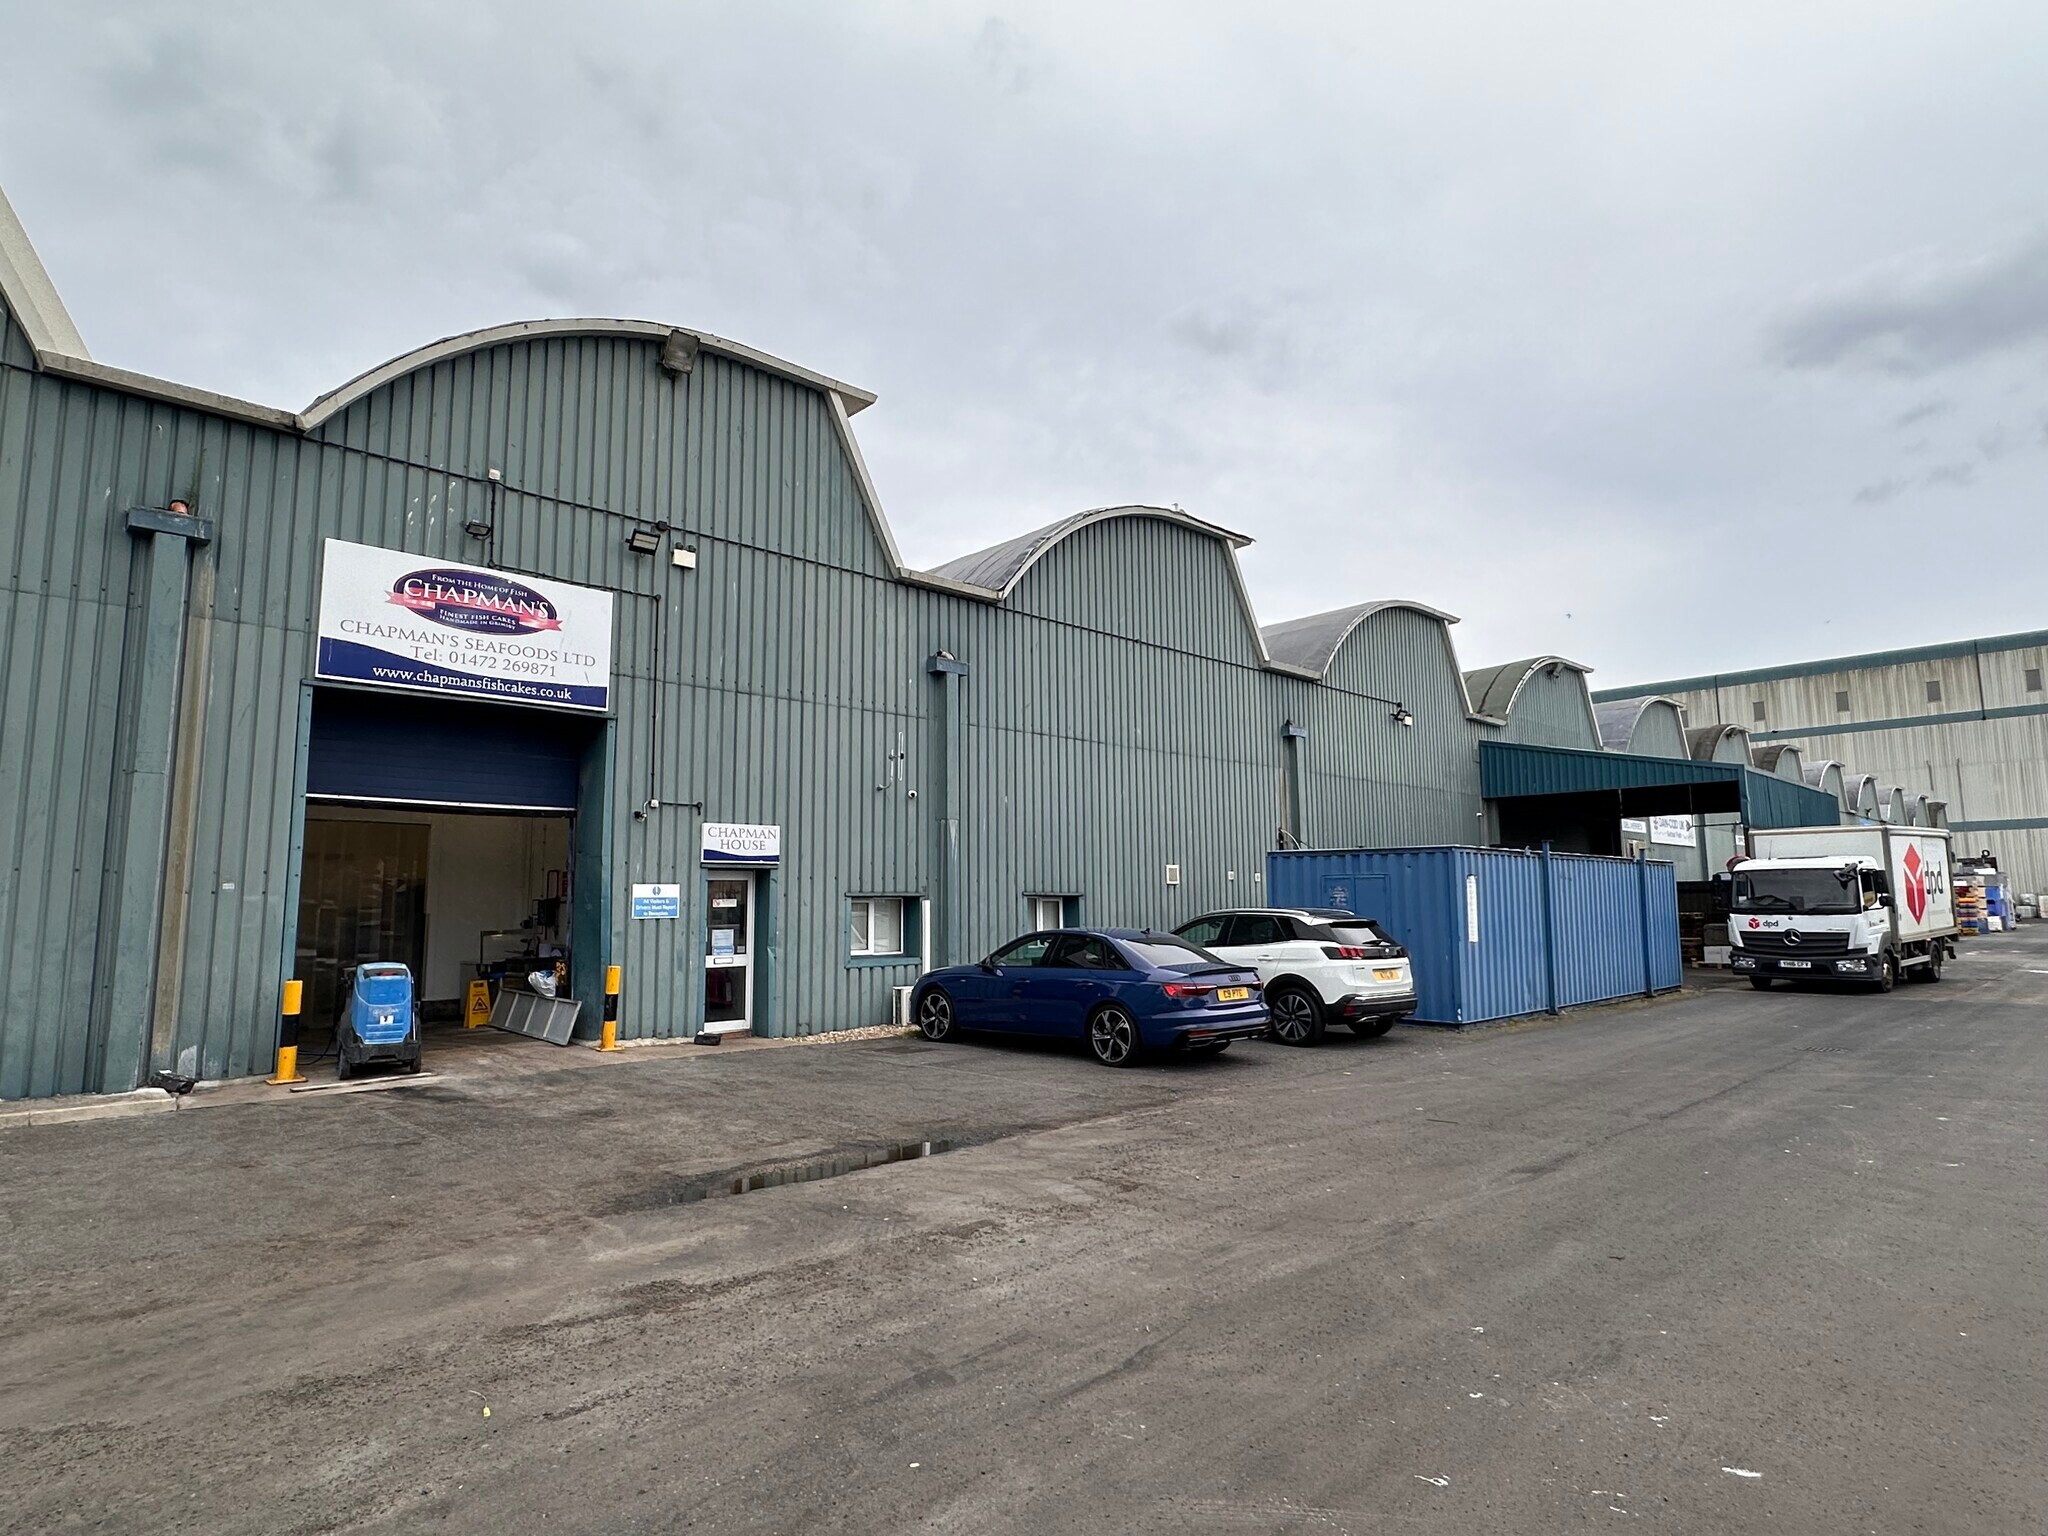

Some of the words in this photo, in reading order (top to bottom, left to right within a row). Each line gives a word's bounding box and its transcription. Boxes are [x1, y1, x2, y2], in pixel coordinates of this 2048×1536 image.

[404, 578, 549, 619] CHAPMAN'S
[432, 573, 457, 585] FROM
[474, 581, 499, 593] HOME
[510, 588, 528, 598] FISH
[439, 609, 469, 620] FINEST
[491, 615, 517, 626] CAKES
[340, 618, 459, 648] CHAPMAN'S
[465, 637, 558, 662] SEAFOODS
[563, 653, 596, 668] LTD
[410, 645, 443, 662] Tel:
[449, 651, 497, 670] 01472
[503, 658, 556, 677] 269871
[372, 665, 572, 701] www.chapmansfishcakes.co.uk
[707, 826, 777, 840] CHAPMAN
[720, 839, 767, 851] HOUSE
[1925, 860, 1944, 904] dpd
[1763, 920, 1779, 928] dpd
